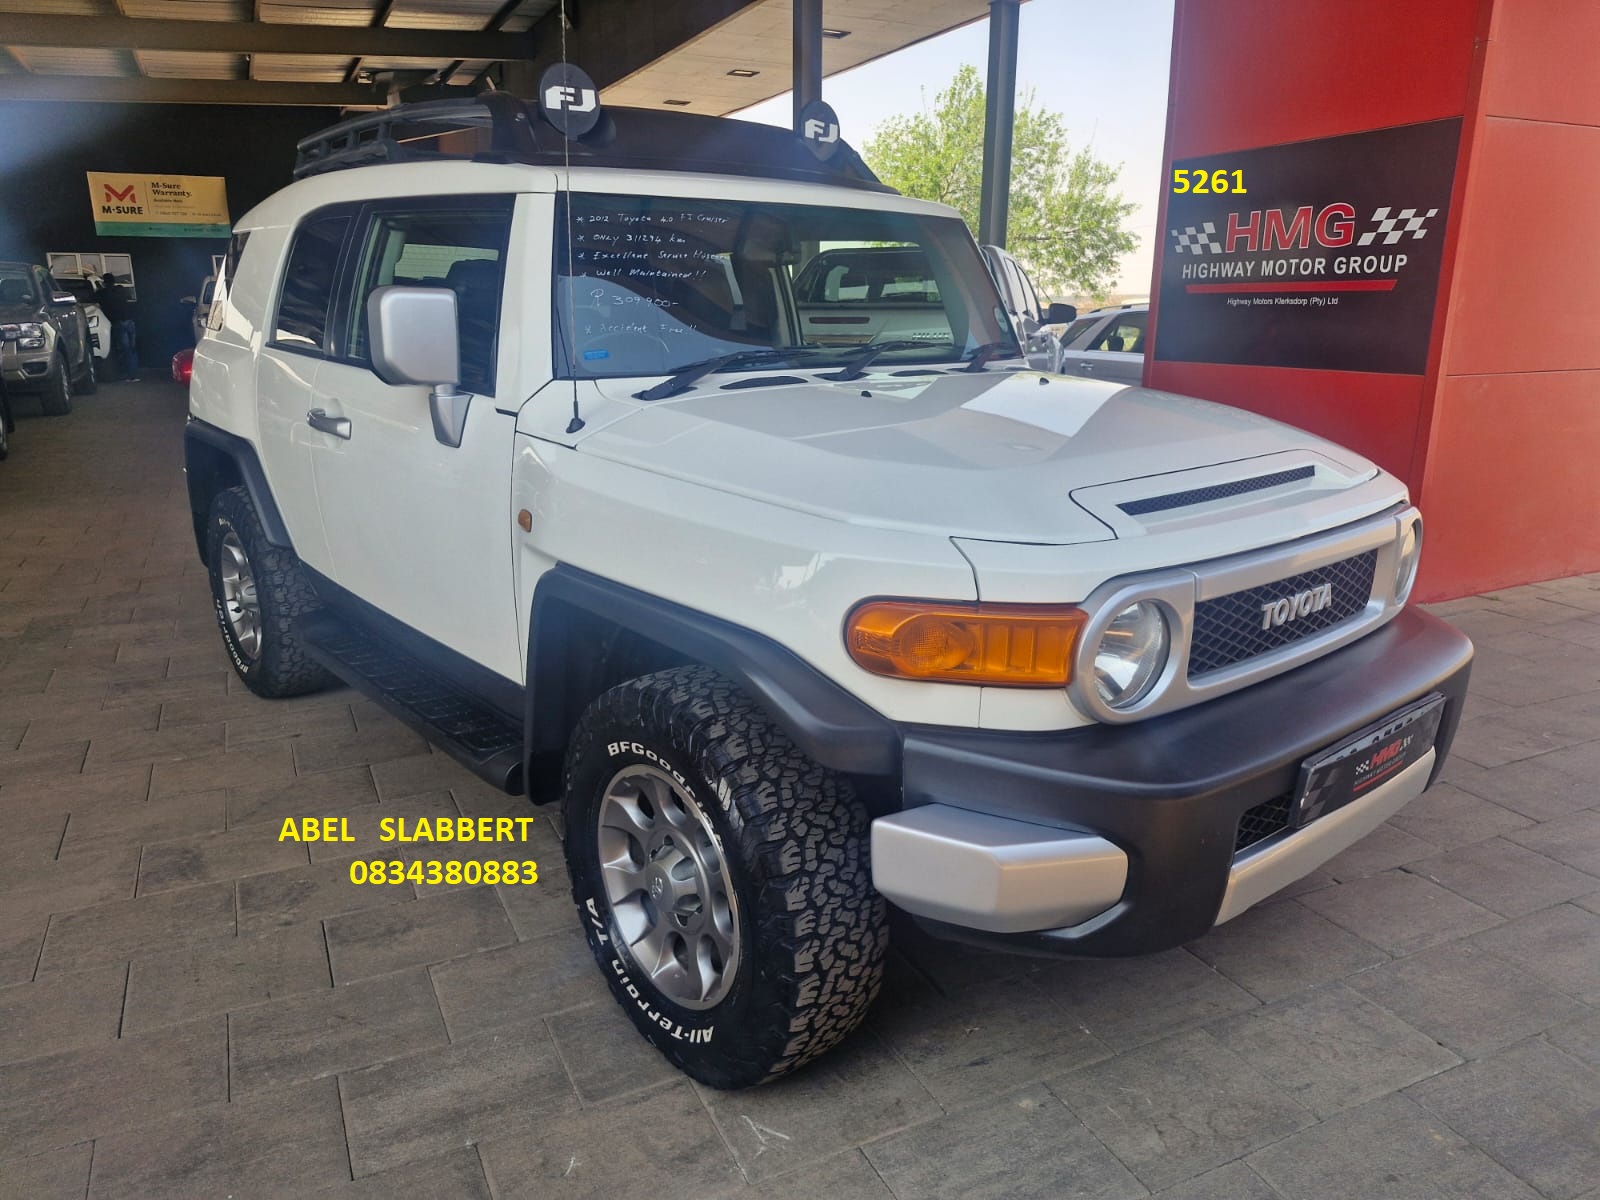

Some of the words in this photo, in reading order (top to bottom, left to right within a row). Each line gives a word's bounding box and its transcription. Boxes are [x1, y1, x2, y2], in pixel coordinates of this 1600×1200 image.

[545, 86, 597, 112] FJ
[804, 119, 838, 143] FJ
[151, 182, 181, 190] M-Sure
[589, 215, 609, 223] 2012
[617, 213, 652, 226] Toyota
[697, 213, 729, 224] Cruiser
[1225, 202, 1356, 253] HMG
[593, 250, 649, 260] Excellent
[658, 250, 688, 260] Service
[1182, 260, 1254, 279] HIGHWAY
[1261, 257, 1326, 277] MOTOR
[1333, 254, 1408, 274] GROUP
[1227, 297, 1251, 306] Highway
[1253, 297, 1273, 305] Motors
[1274, 297, 1308, 306] Klerksdorp
[1309, 296, 1326, 307] (Pty)
[1327, 297, 1339, 305] Ltd
[1261, 583, 1332, 630] TOYOTA
